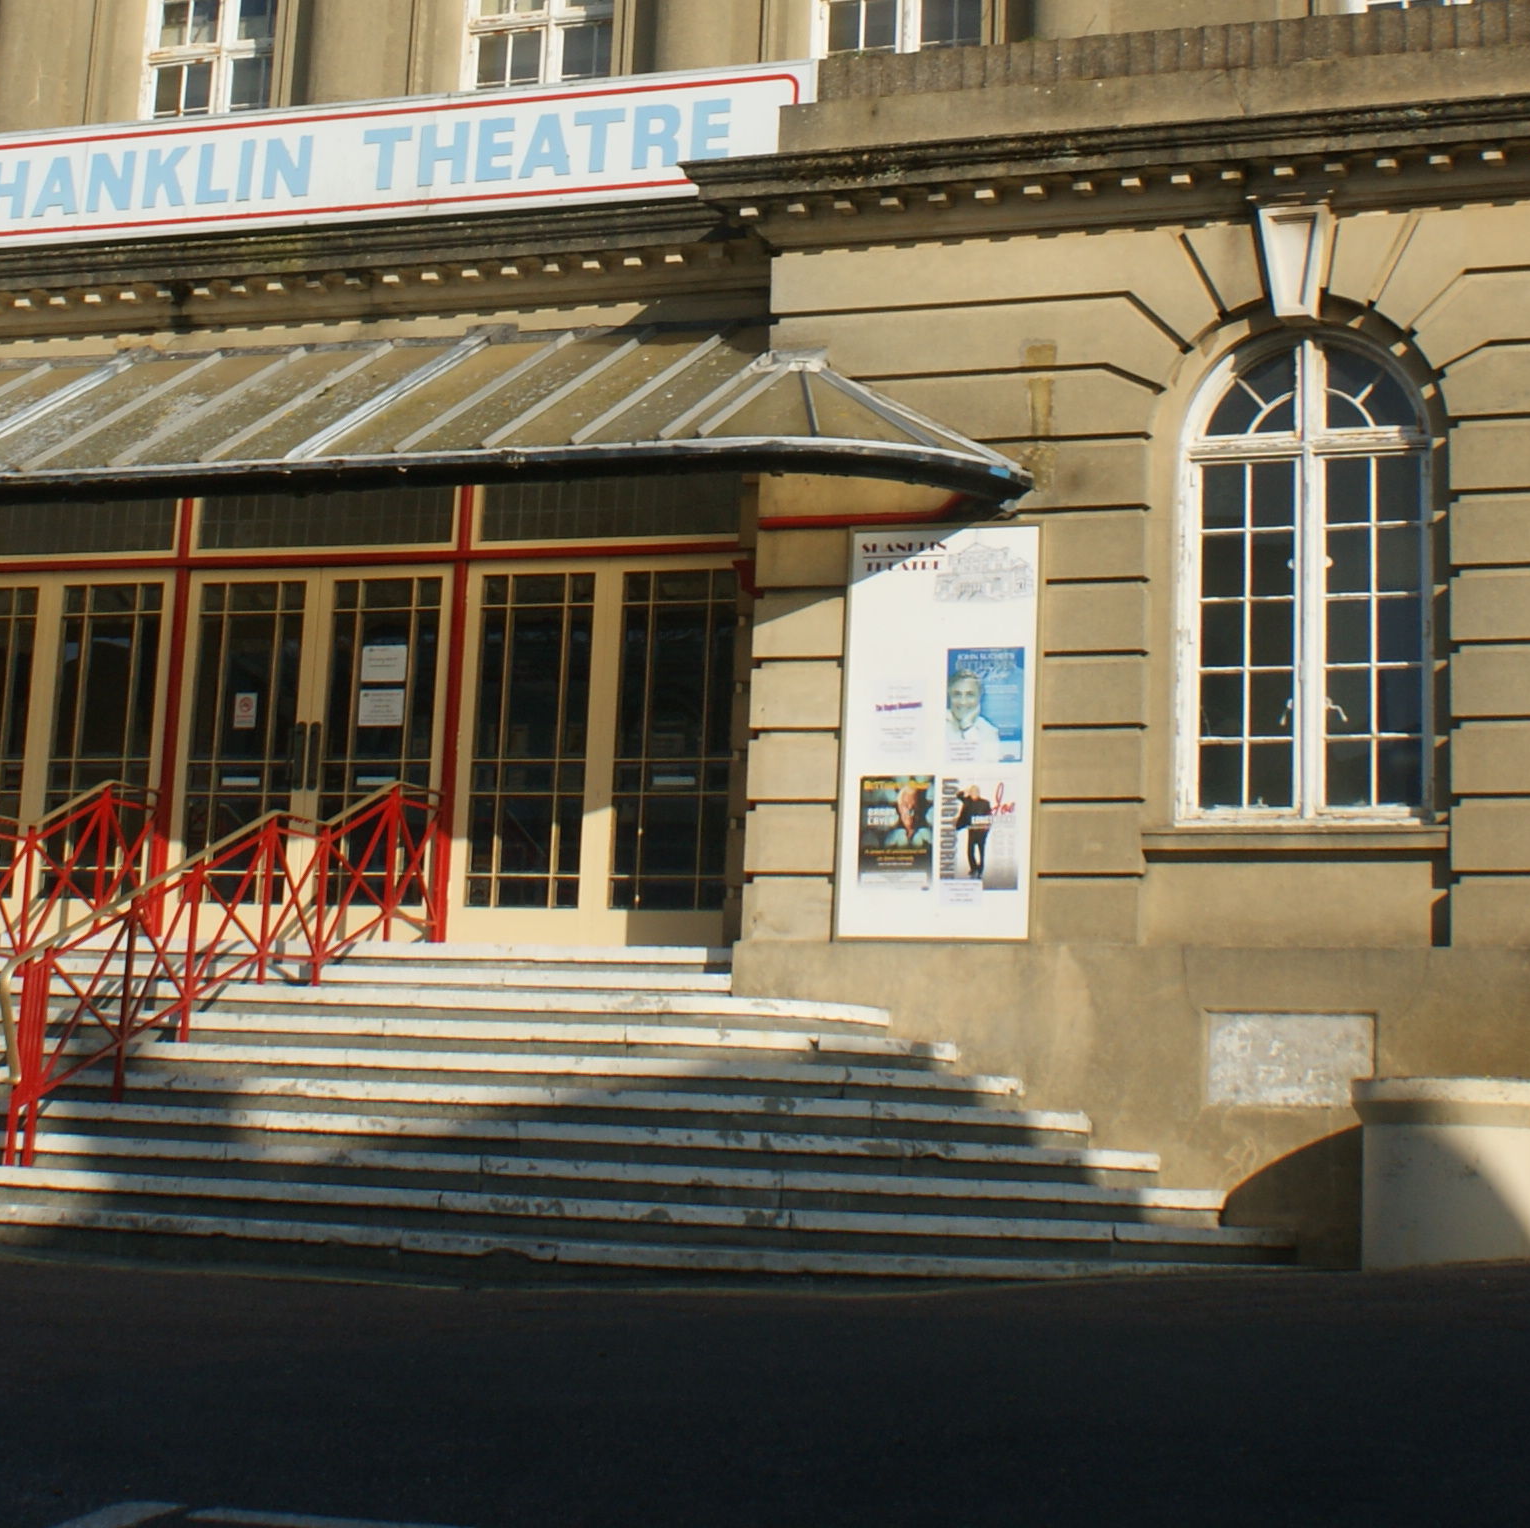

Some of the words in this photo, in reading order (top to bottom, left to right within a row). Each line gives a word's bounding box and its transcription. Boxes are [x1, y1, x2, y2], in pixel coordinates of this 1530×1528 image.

[363, 99, 733, 191] THEATRE
[861, 540, 947, 554] SHANKLIN
[865, 560, 942, 572] THEATRE
